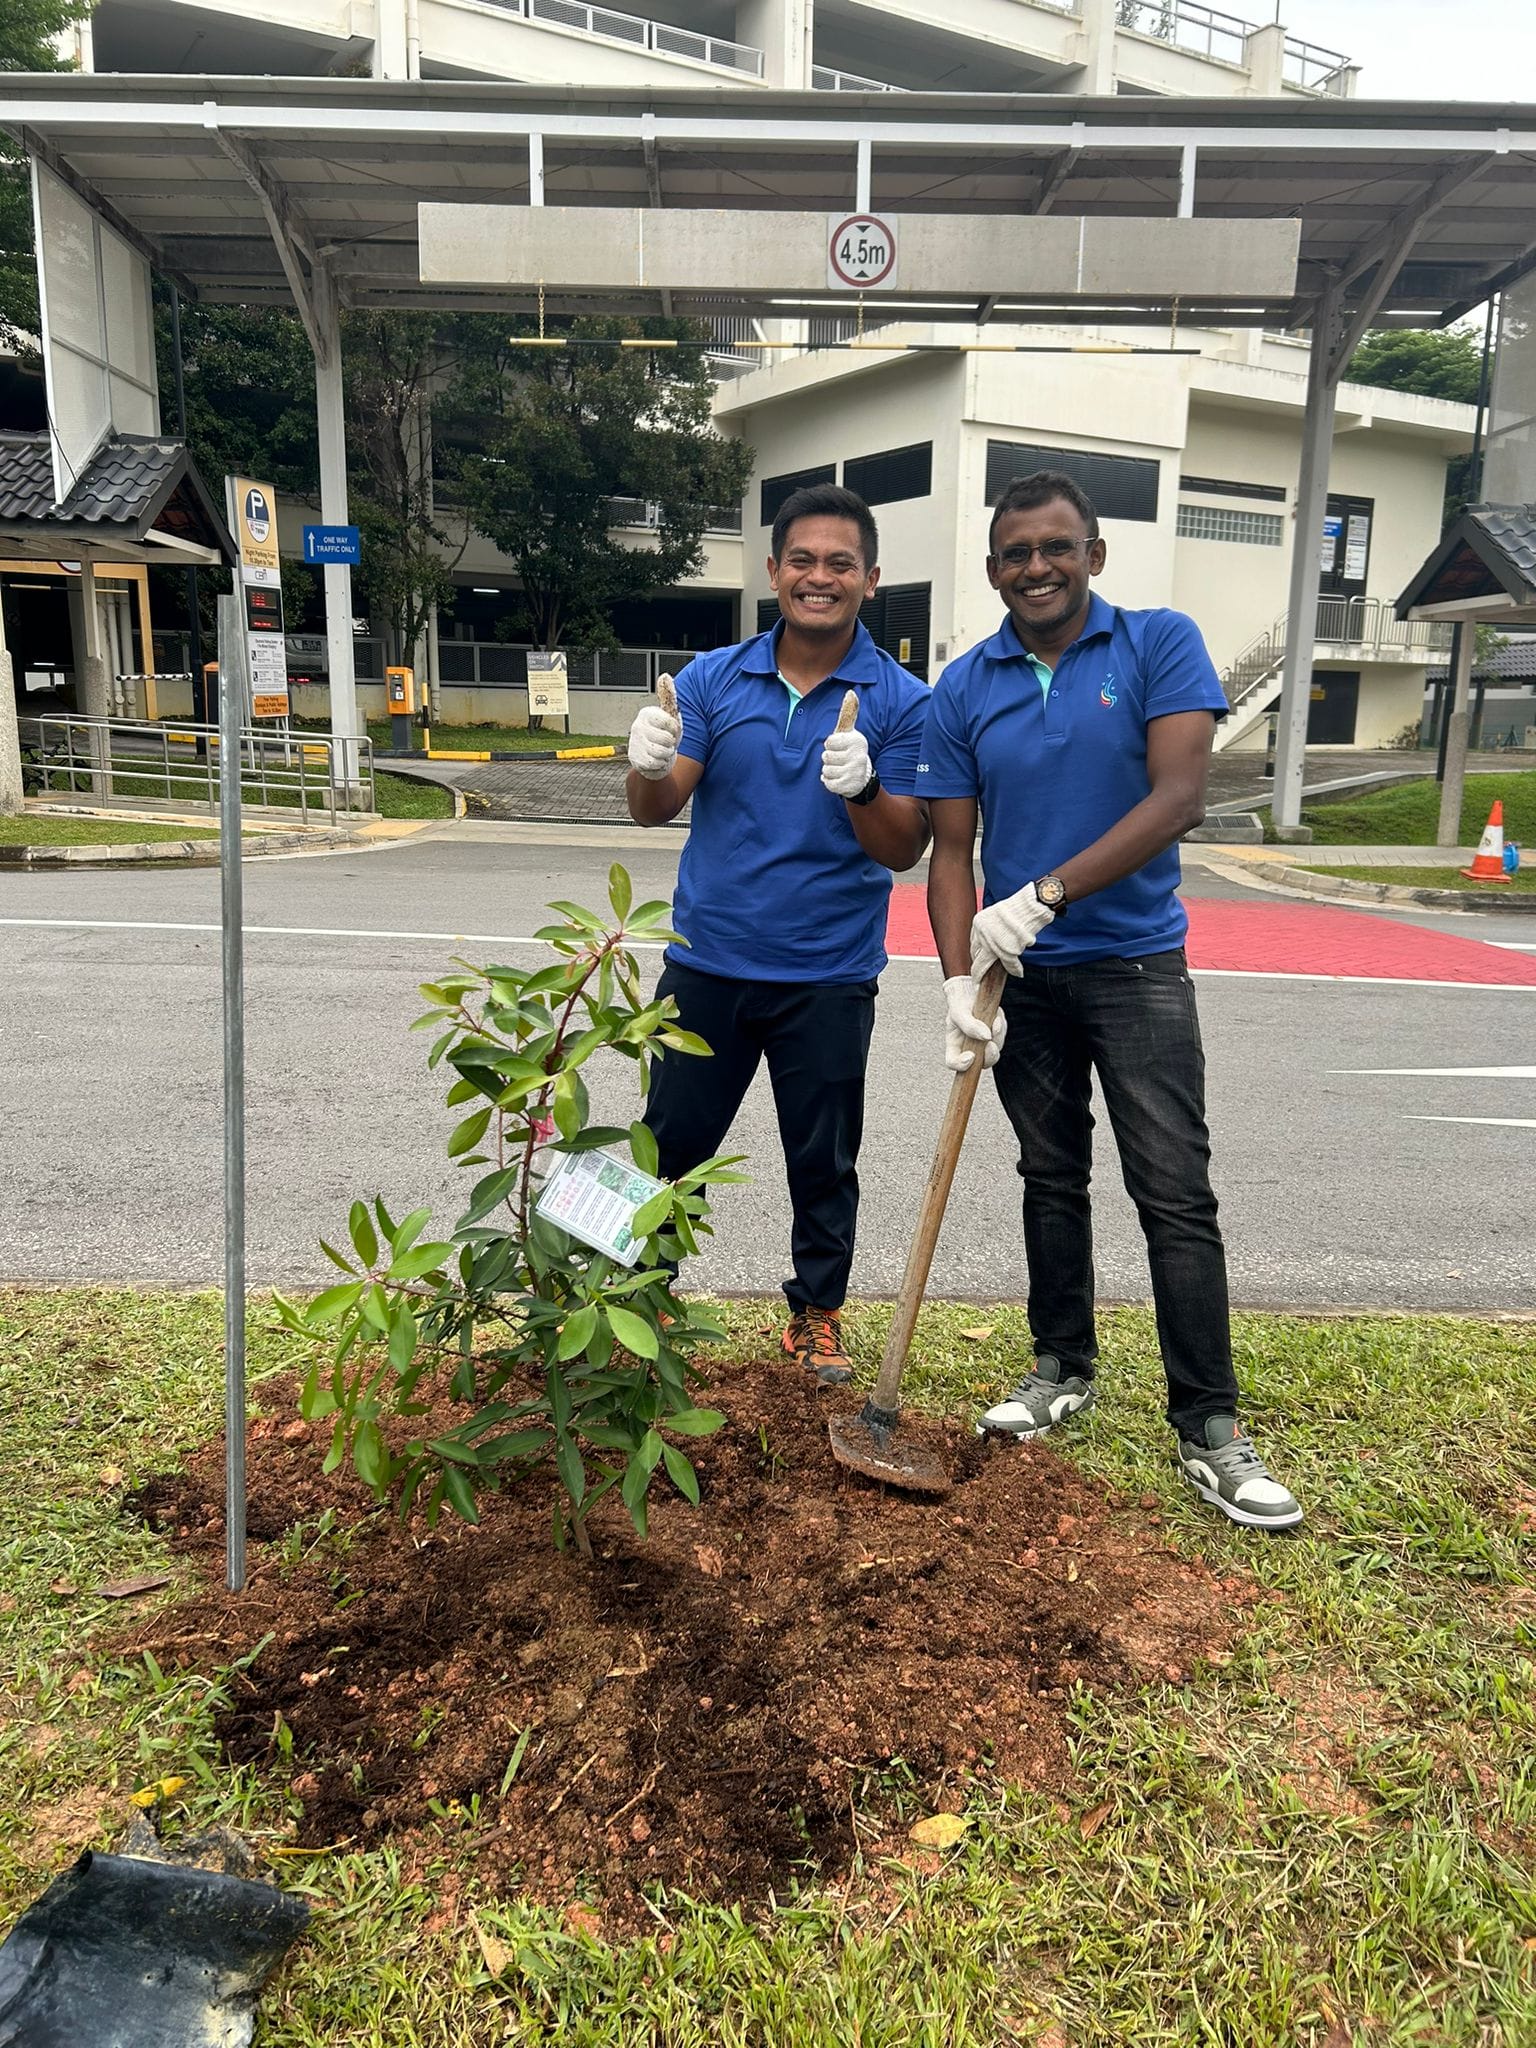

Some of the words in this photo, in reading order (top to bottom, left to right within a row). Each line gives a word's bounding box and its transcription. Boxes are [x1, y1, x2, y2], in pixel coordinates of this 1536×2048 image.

[840, 238, 885, 264] 4.5m
[251, 491, 264, 518] P
[317, 545, 340, 553] TRAFFIC
[341, 545, 356, 553] ONLY
[323, 536, 336, 544] ONE
[336, 537, 348, 545] WAY
